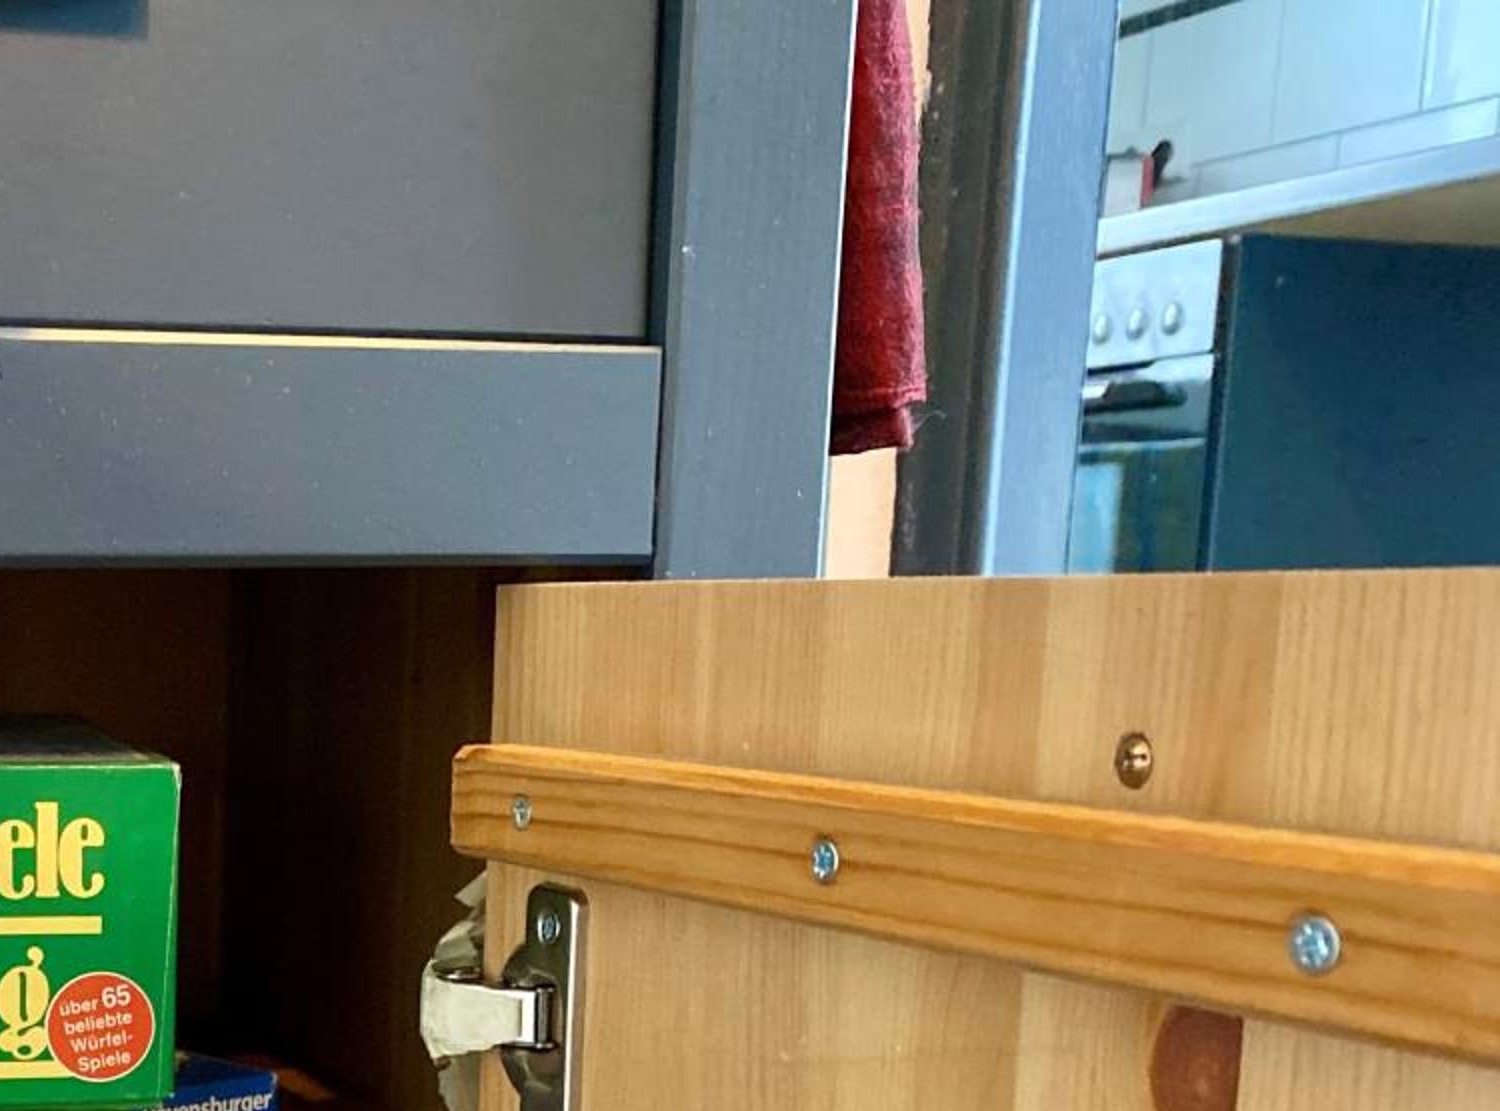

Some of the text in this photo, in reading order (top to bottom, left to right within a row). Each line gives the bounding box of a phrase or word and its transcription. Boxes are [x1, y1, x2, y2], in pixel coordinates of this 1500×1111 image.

[59, 983, 132, 1017] über 65
[64, 1011, 134, 1036] beliebte
[70, 1030, 134, 1053] Würfel-
[77, 1051, 133, 1073] Spiele
